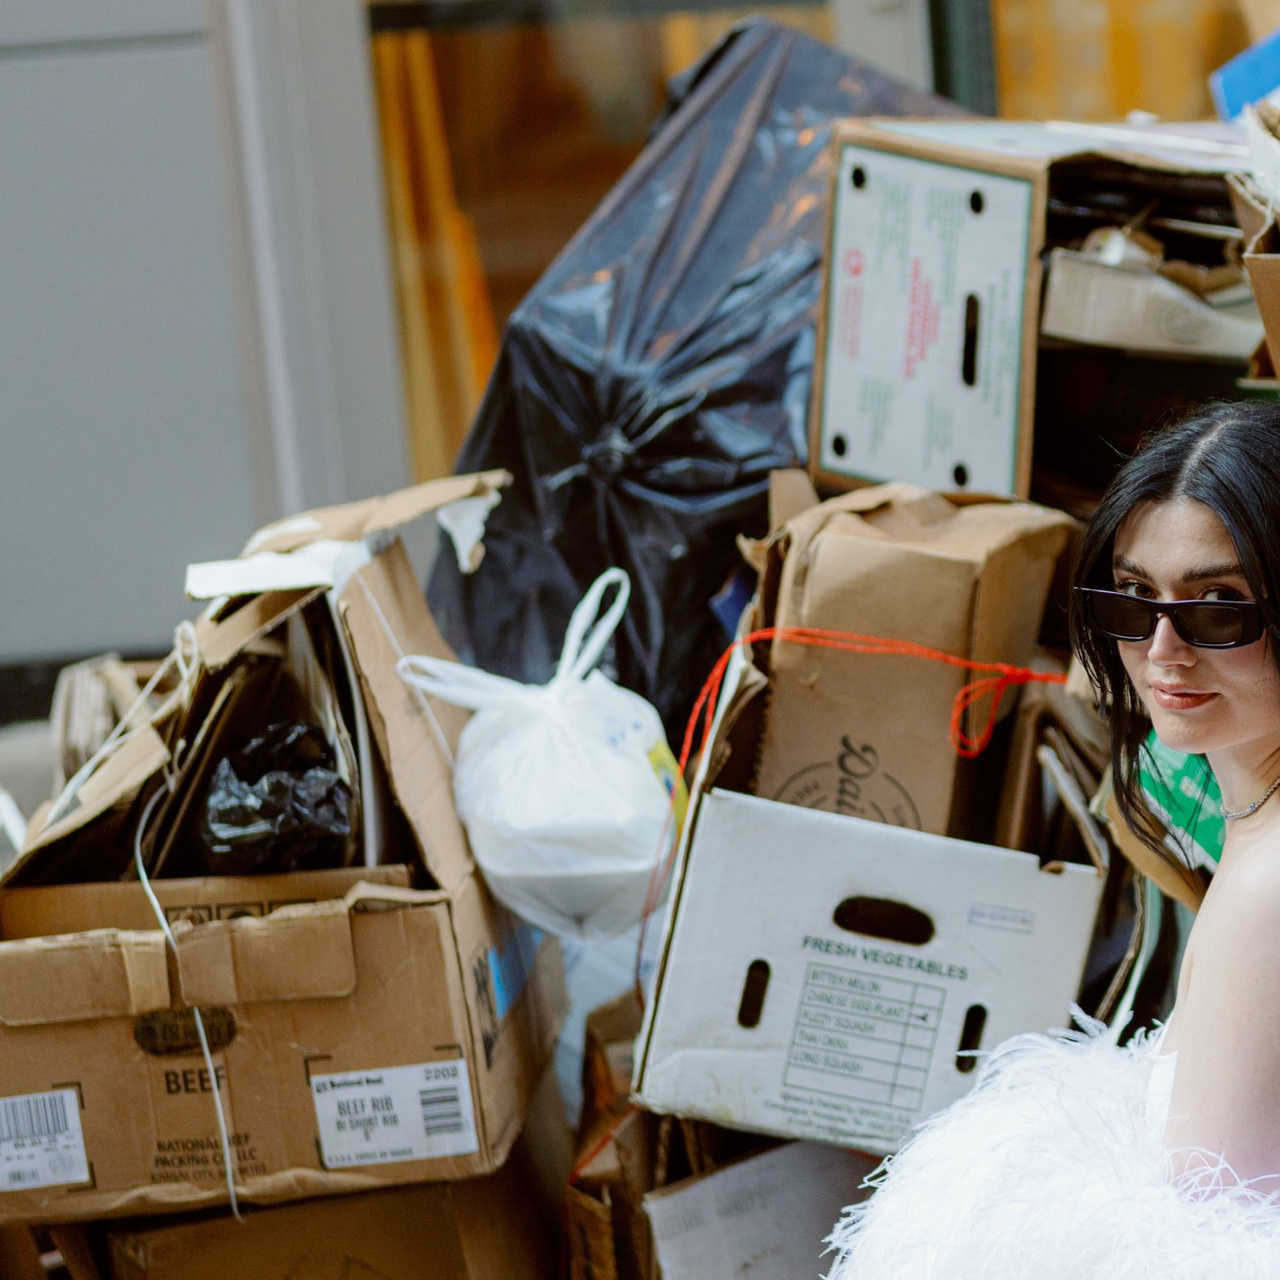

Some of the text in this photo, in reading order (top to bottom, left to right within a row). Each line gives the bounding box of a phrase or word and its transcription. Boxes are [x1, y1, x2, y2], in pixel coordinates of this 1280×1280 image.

[837, 734, 880, 814] Dai
[802, 935, 970, 981] FRESH VEGETABLES
[836, 1016, 876, 1033] SQUASH
[823, 1056, 863, 1073] SQUASH
[165, 1066, 226, 1095] BEEF
[337, 1095, 394, 1117] BEEF RIB
[156, 1133, 250, 1152] NATIONAL EEF
[154, 1153, 210, 1168] PACKING
